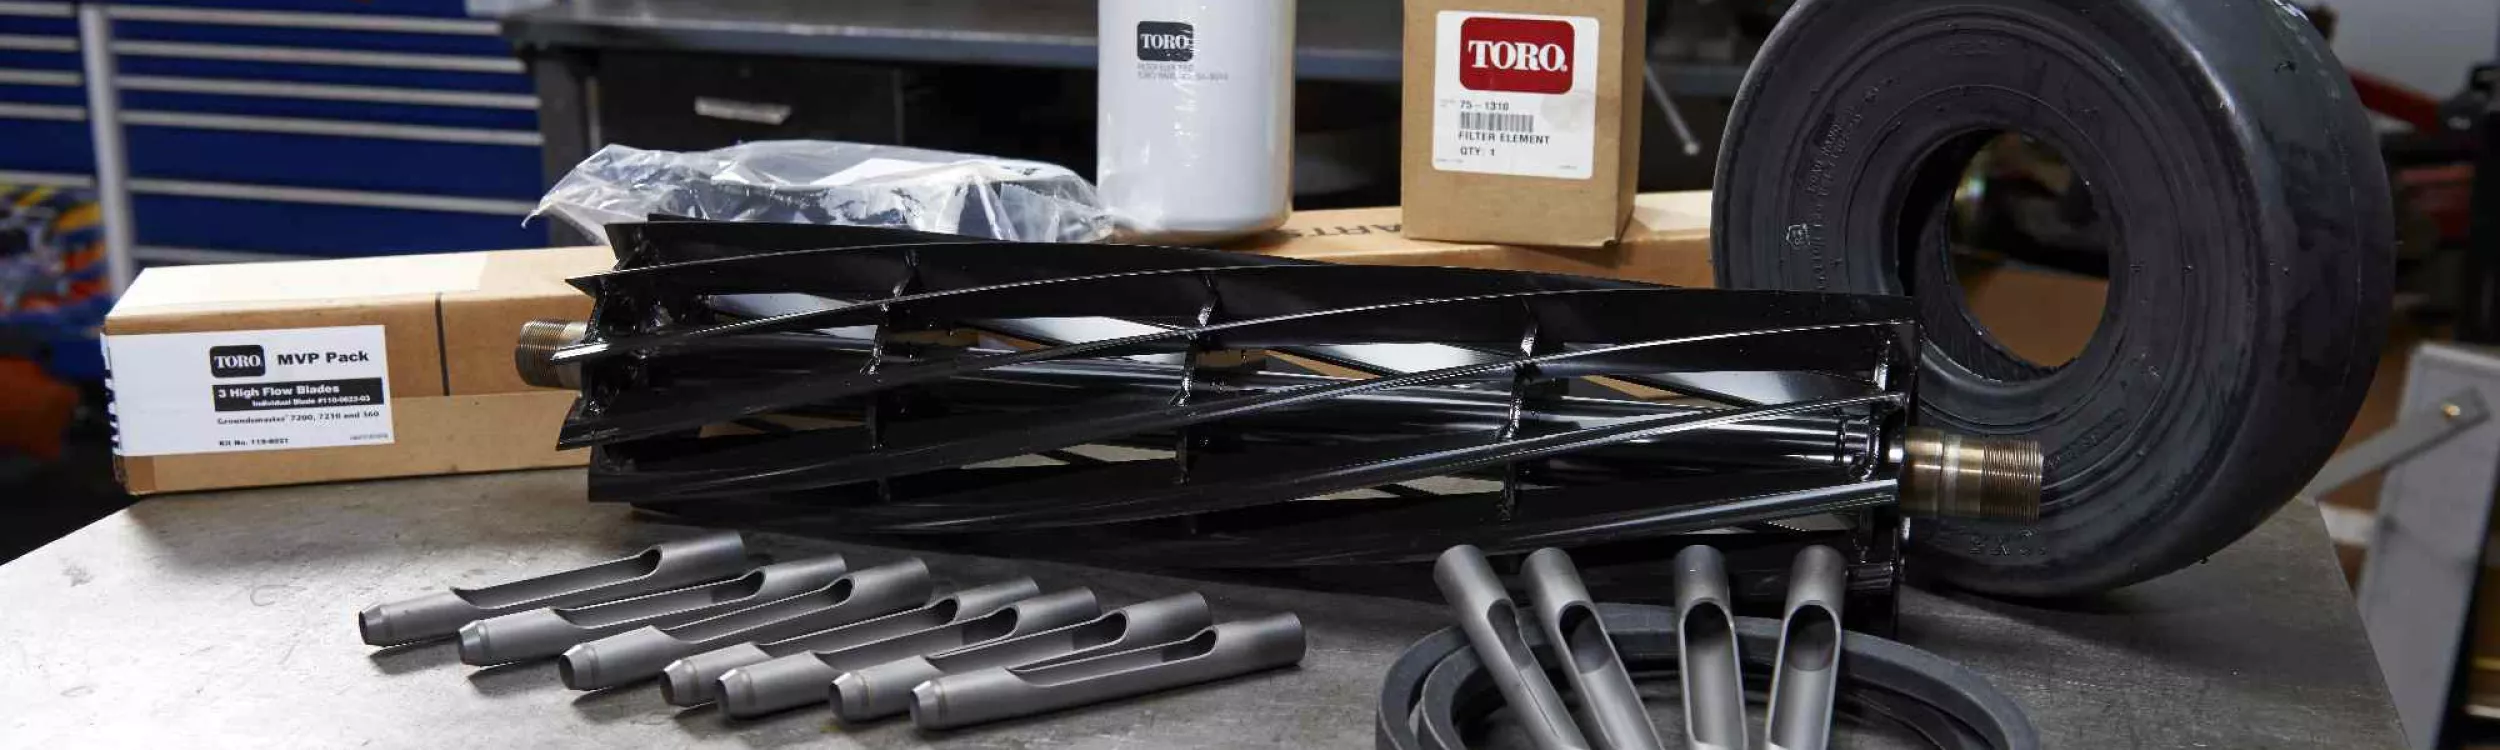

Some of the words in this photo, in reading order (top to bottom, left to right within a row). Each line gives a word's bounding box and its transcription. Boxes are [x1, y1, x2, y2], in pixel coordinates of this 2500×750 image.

[1140, 34, 1188, 49] TORO
[1467, 40, 1567, 72] TORO
[1458, 131, 1496, 142] FILTER
[1499, 132, 1550, 144] ELEMENT
[214, 354, 262, 369] TORO
[277, 352, 320, 366] MVP
[326, 350, 369, 364] Pack
[218, 390, 226, 399] 3
[230, 387, 259, 400] High
[263, 386, 293, 397] Flow
[297, 384, 340, 395] Blades
